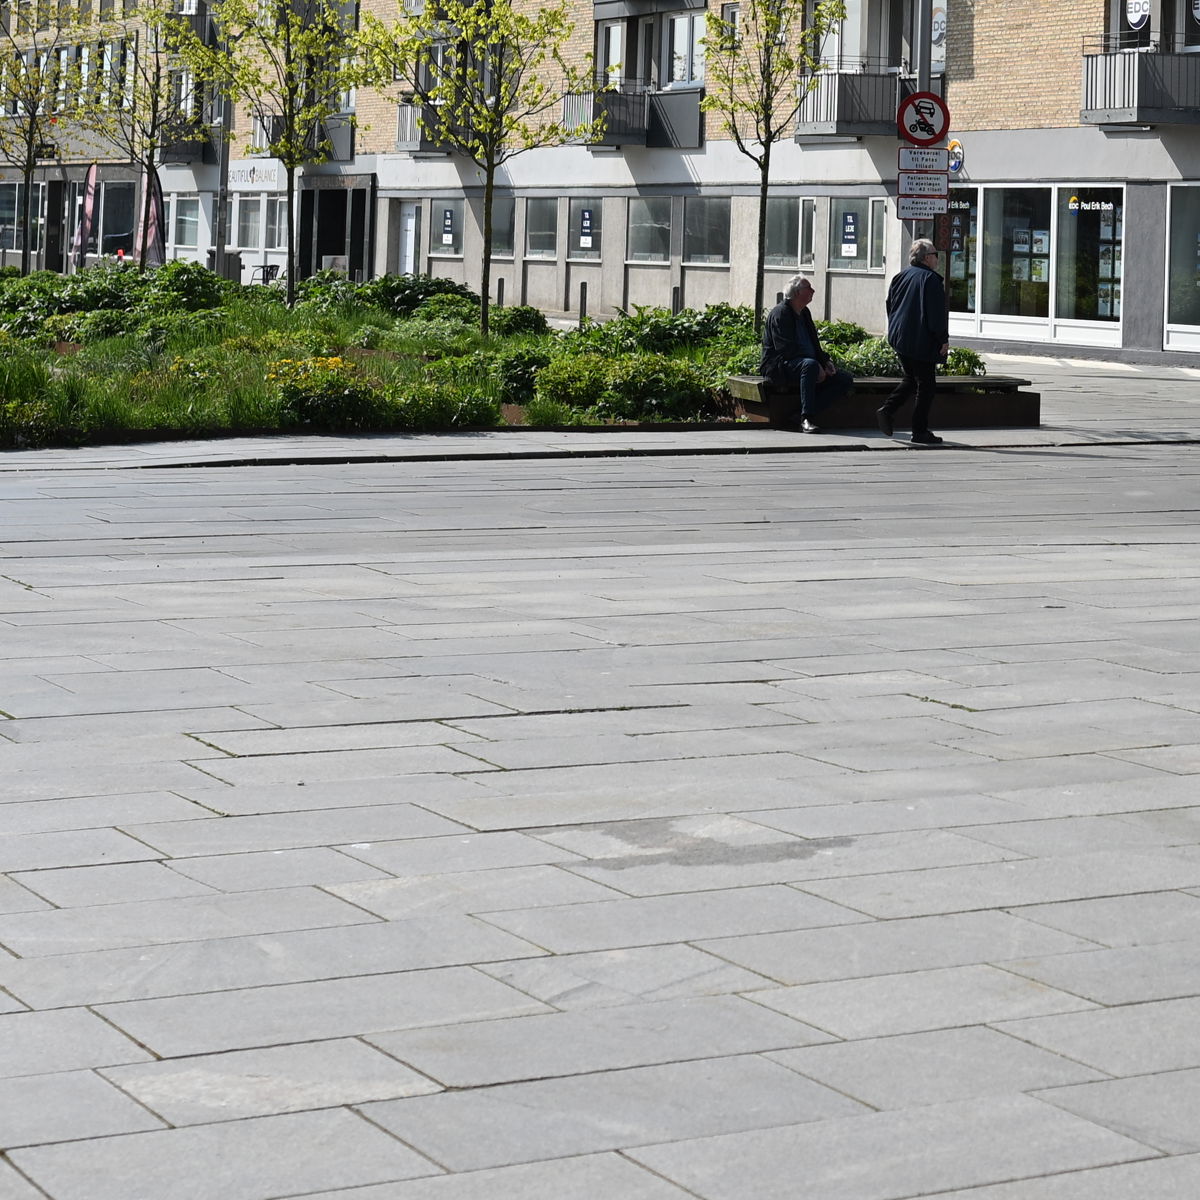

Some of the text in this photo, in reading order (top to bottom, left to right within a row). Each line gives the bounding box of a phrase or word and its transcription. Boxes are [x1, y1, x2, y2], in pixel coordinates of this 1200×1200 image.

[1127, 1, 1149, 14] EDC
[934, 20, 946, 32] DC
[227, 169, 250, 183] EAUTIFUL
[1080, 201, 1091, 211] Poul
[1091, 201, 1101, 210] Erik
[1101, 201, 1114, 211] Bech
